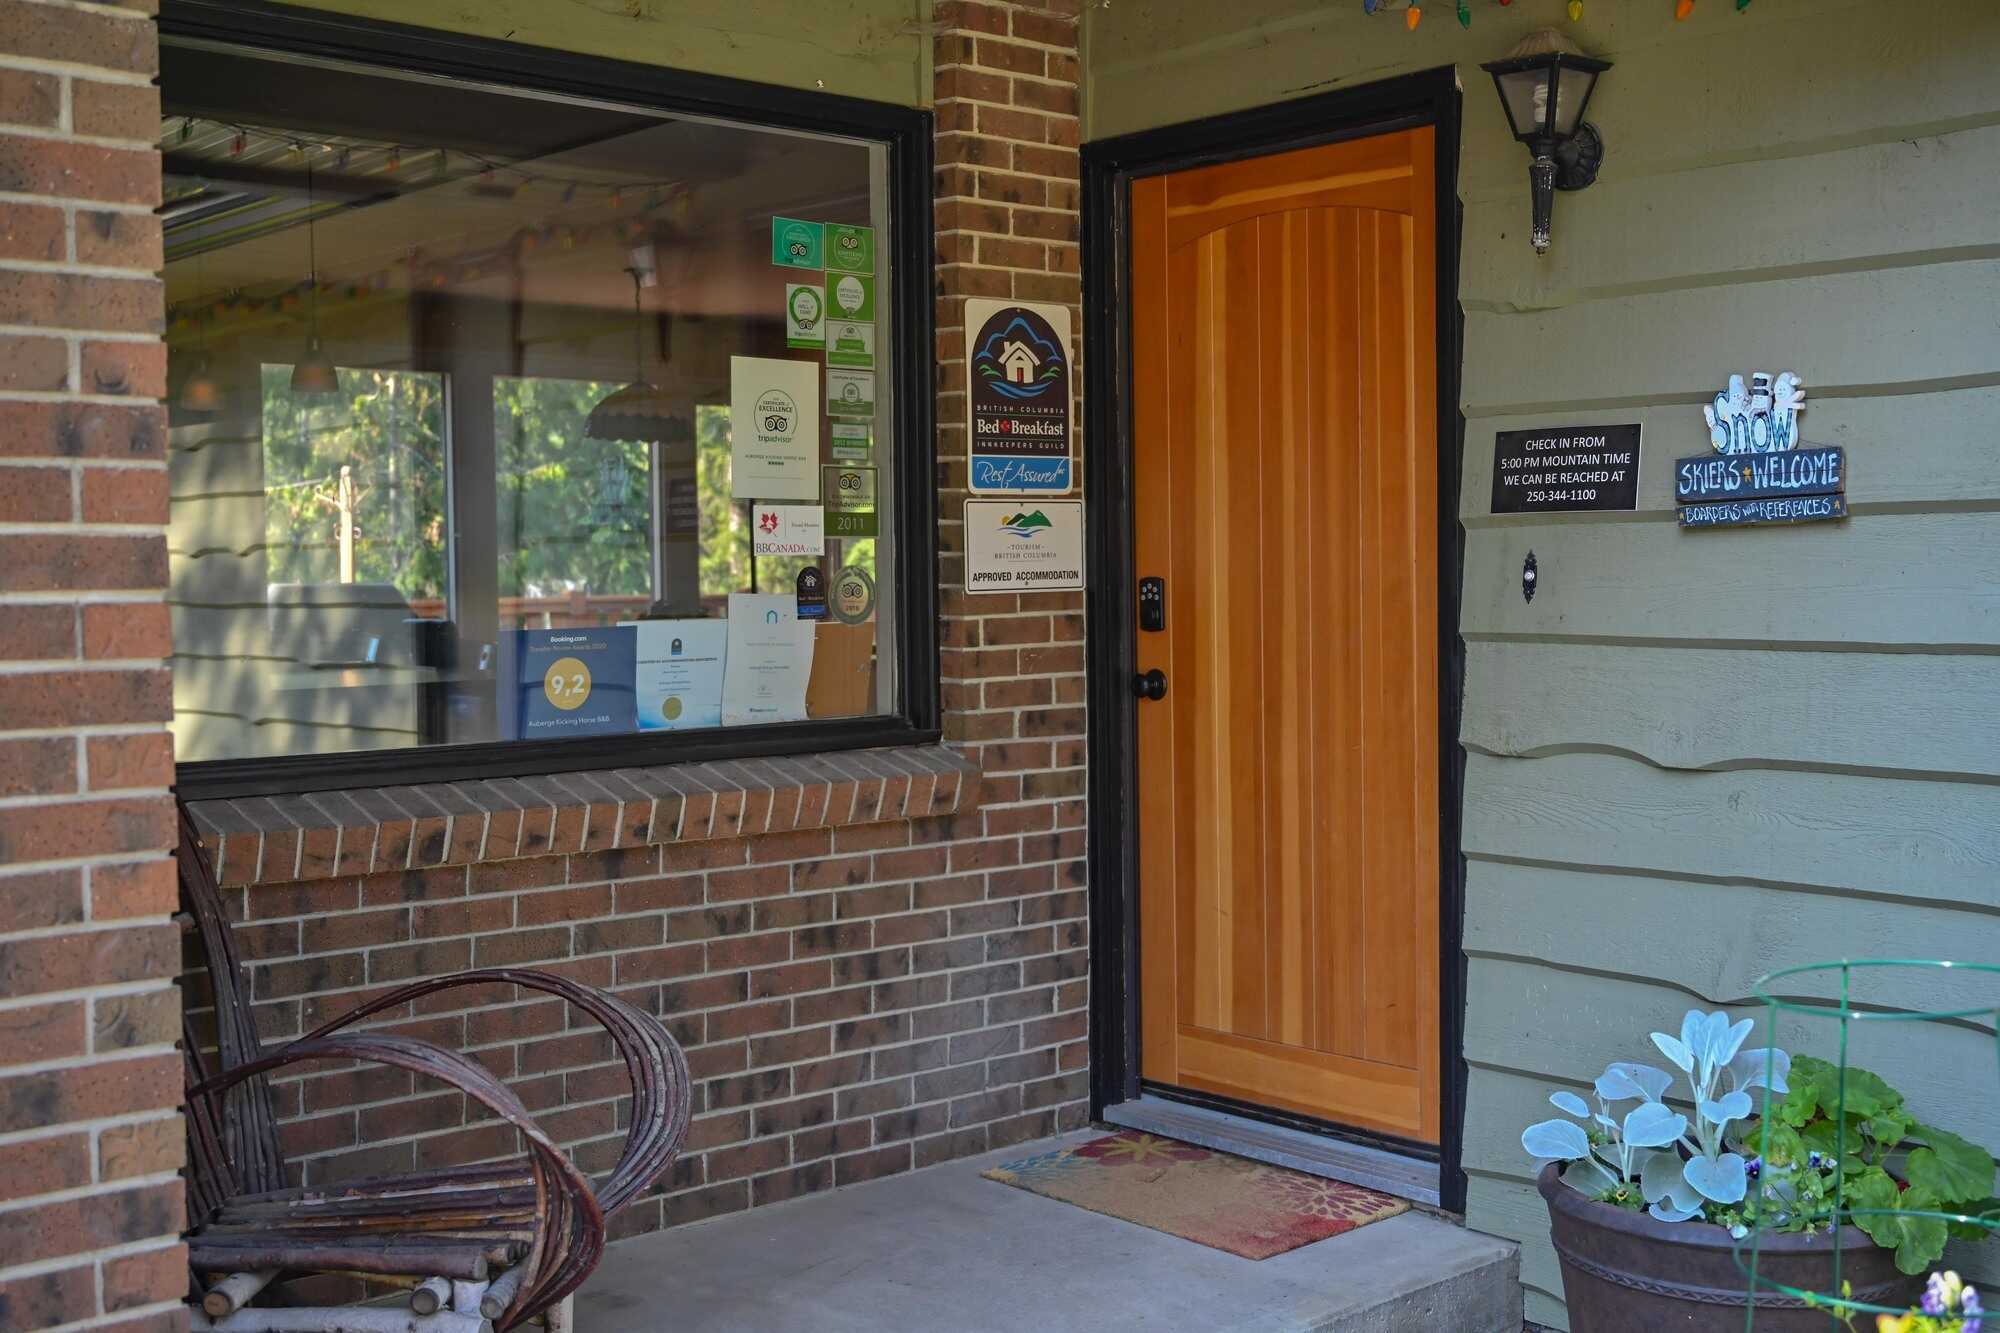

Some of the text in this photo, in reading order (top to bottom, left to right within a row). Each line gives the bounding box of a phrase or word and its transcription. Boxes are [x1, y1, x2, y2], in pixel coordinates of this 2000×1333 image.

[758, 405, 793, 413] EXCELLENCE
[1021, 406, 1064, 414] COLUMBIA
[977, 419, 1000, 434] Bed
[1011, 420, 1064, 436] Breakfast
[758, 435, 792, 443] tripadvisor
[977, 441, 1033, 449] INNKEEPERS
[1525, 436, 1605, 451] CHECK IN FROM
[1501, 452, 1631, 469] 5:00 PM MOUNTAIN TIME
[976, 457, 1065, 489] Rest Assured
[1504, 470, 1625, 486] WE CAN BE REACHED AT
[1679, 452, 1839, 494] SKIERS WELCOME
[1526, 489, 1597, 502] 250-344-1100
[1685, 504, 1741, 523] BOARDERS
[1759, 497, 1831, 519] REFERENCES
[837, 516, 865, 530] 2011
[994, 551, 1057, 560] BRITISH COLUMBIA
[972, 570, 1079, 582] APPROVED ACCOMMODATION
[551, 674, 585, 697] 9,2
